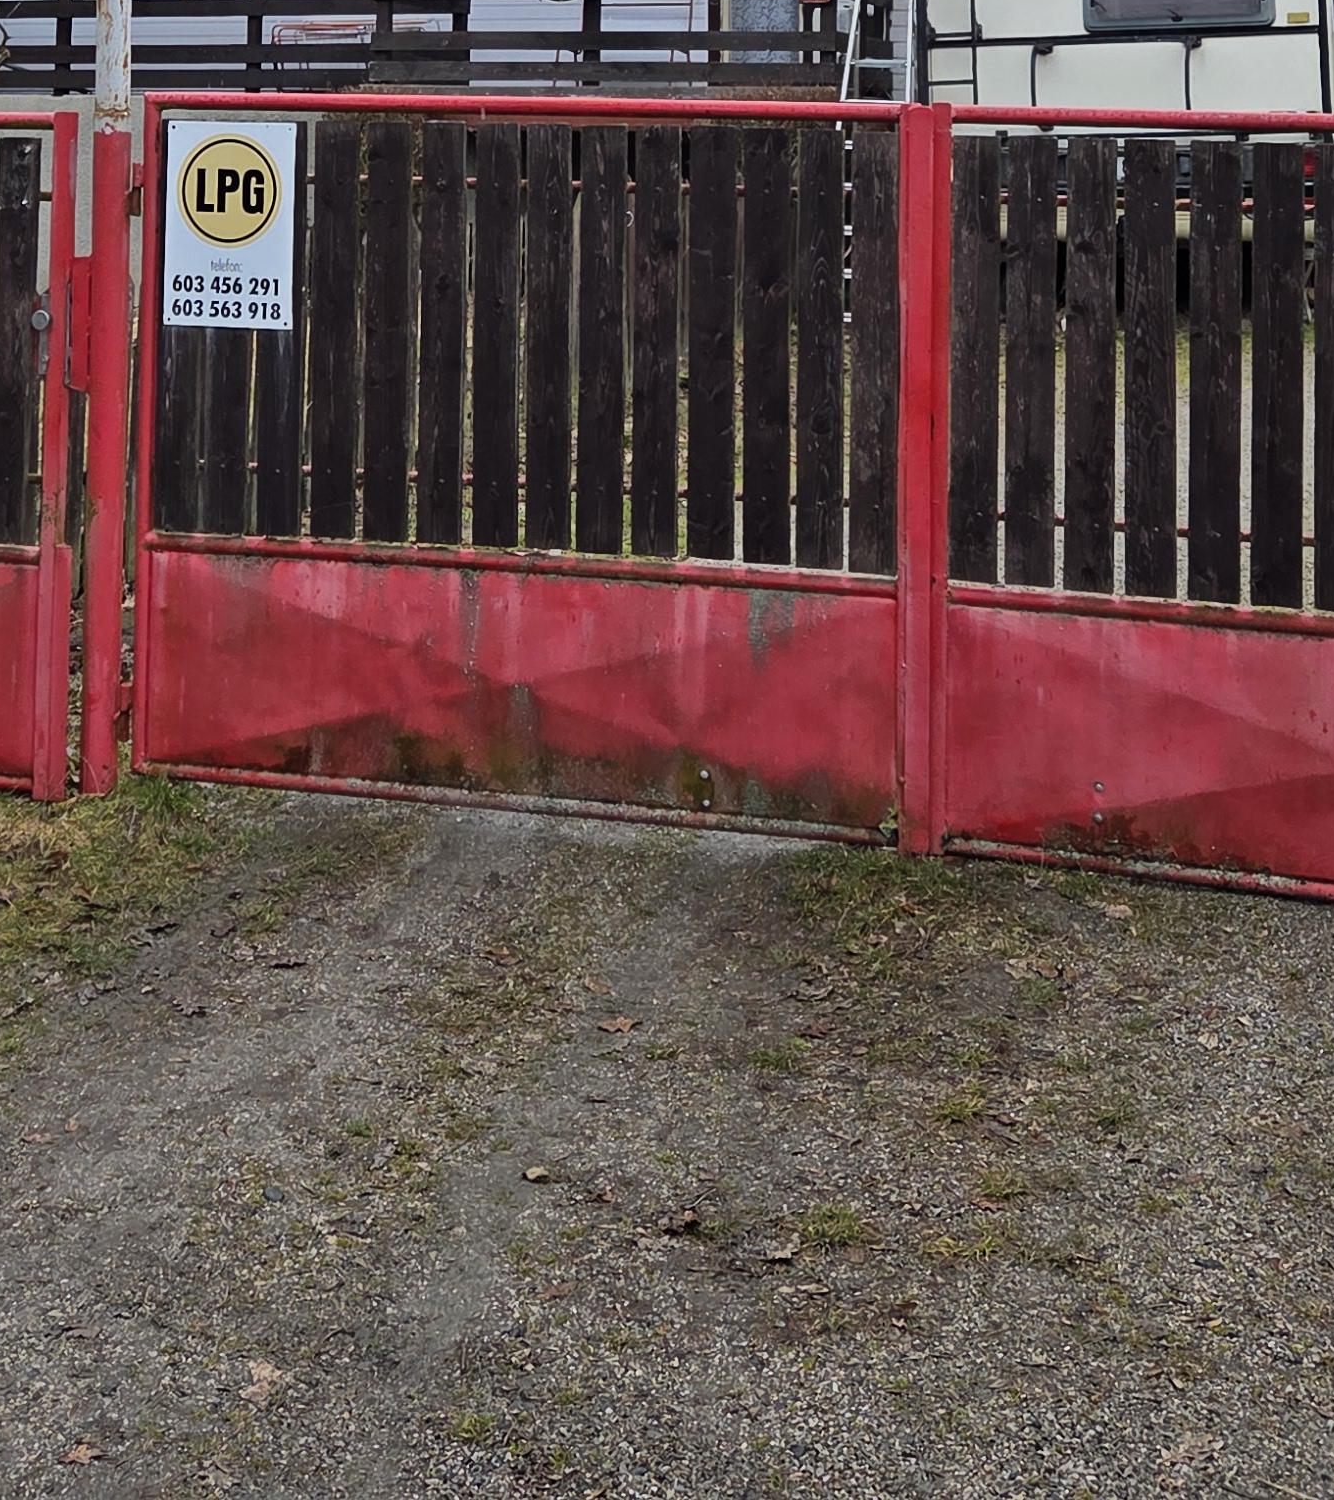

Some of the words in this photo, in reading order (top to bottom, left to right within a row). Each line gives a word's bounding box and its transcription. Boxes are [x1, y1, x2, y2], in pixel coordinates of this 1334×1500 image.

[195, 168, 265, 215] LPG
[210, 258, 243, 273] telefon:
[172, 275, 205, 293] 603
[210, 276, 243, 295] 456
[249, 278, 279, 296] 291
[171, 299, 204, 318] 603
[208, 300, 242, 319] 563
[248, 302, 282, 320] 918
